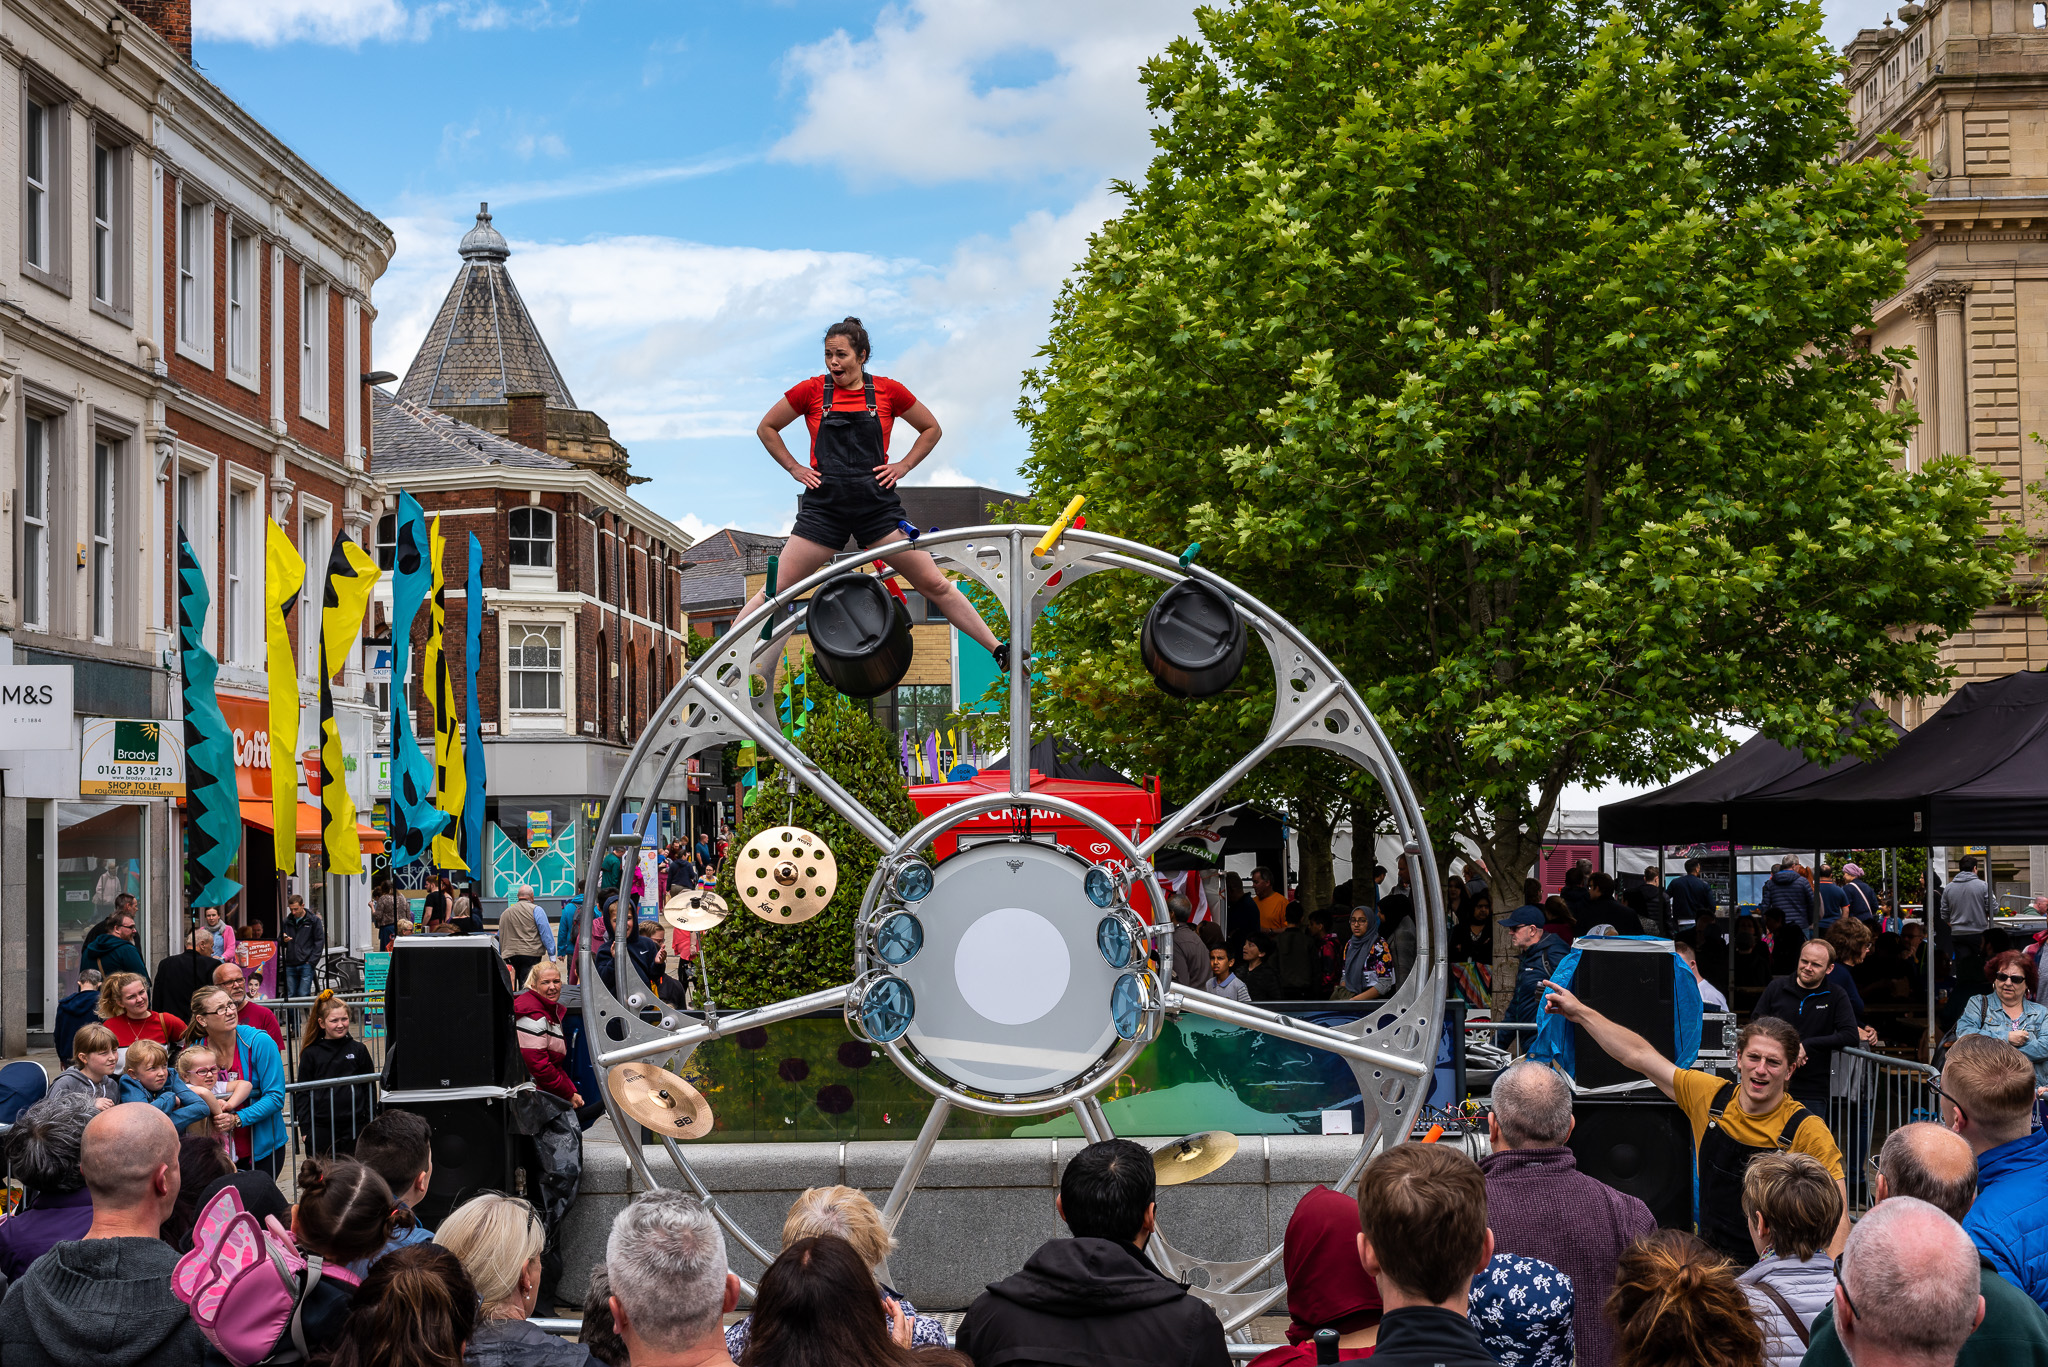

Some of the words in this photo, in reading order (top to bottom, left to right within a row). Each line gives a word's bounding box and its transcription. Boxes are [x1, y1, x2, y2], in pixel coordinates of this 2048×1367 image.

[3, 685, 53, 705] M&S
[117, 749, 156, 762] Bradys
[233, 728, 272, 769] Coff
[98, 765, 122, 775] 0161
[125, 766, 145, 776] 839
[150, 766, 173, 777] 1213
[108, 781, 132, 790] SHOP
[134, 782, 146, 790] TO
[149, 782, 162, 790] LET
[1180, 845, 1213, 861] CREAM
